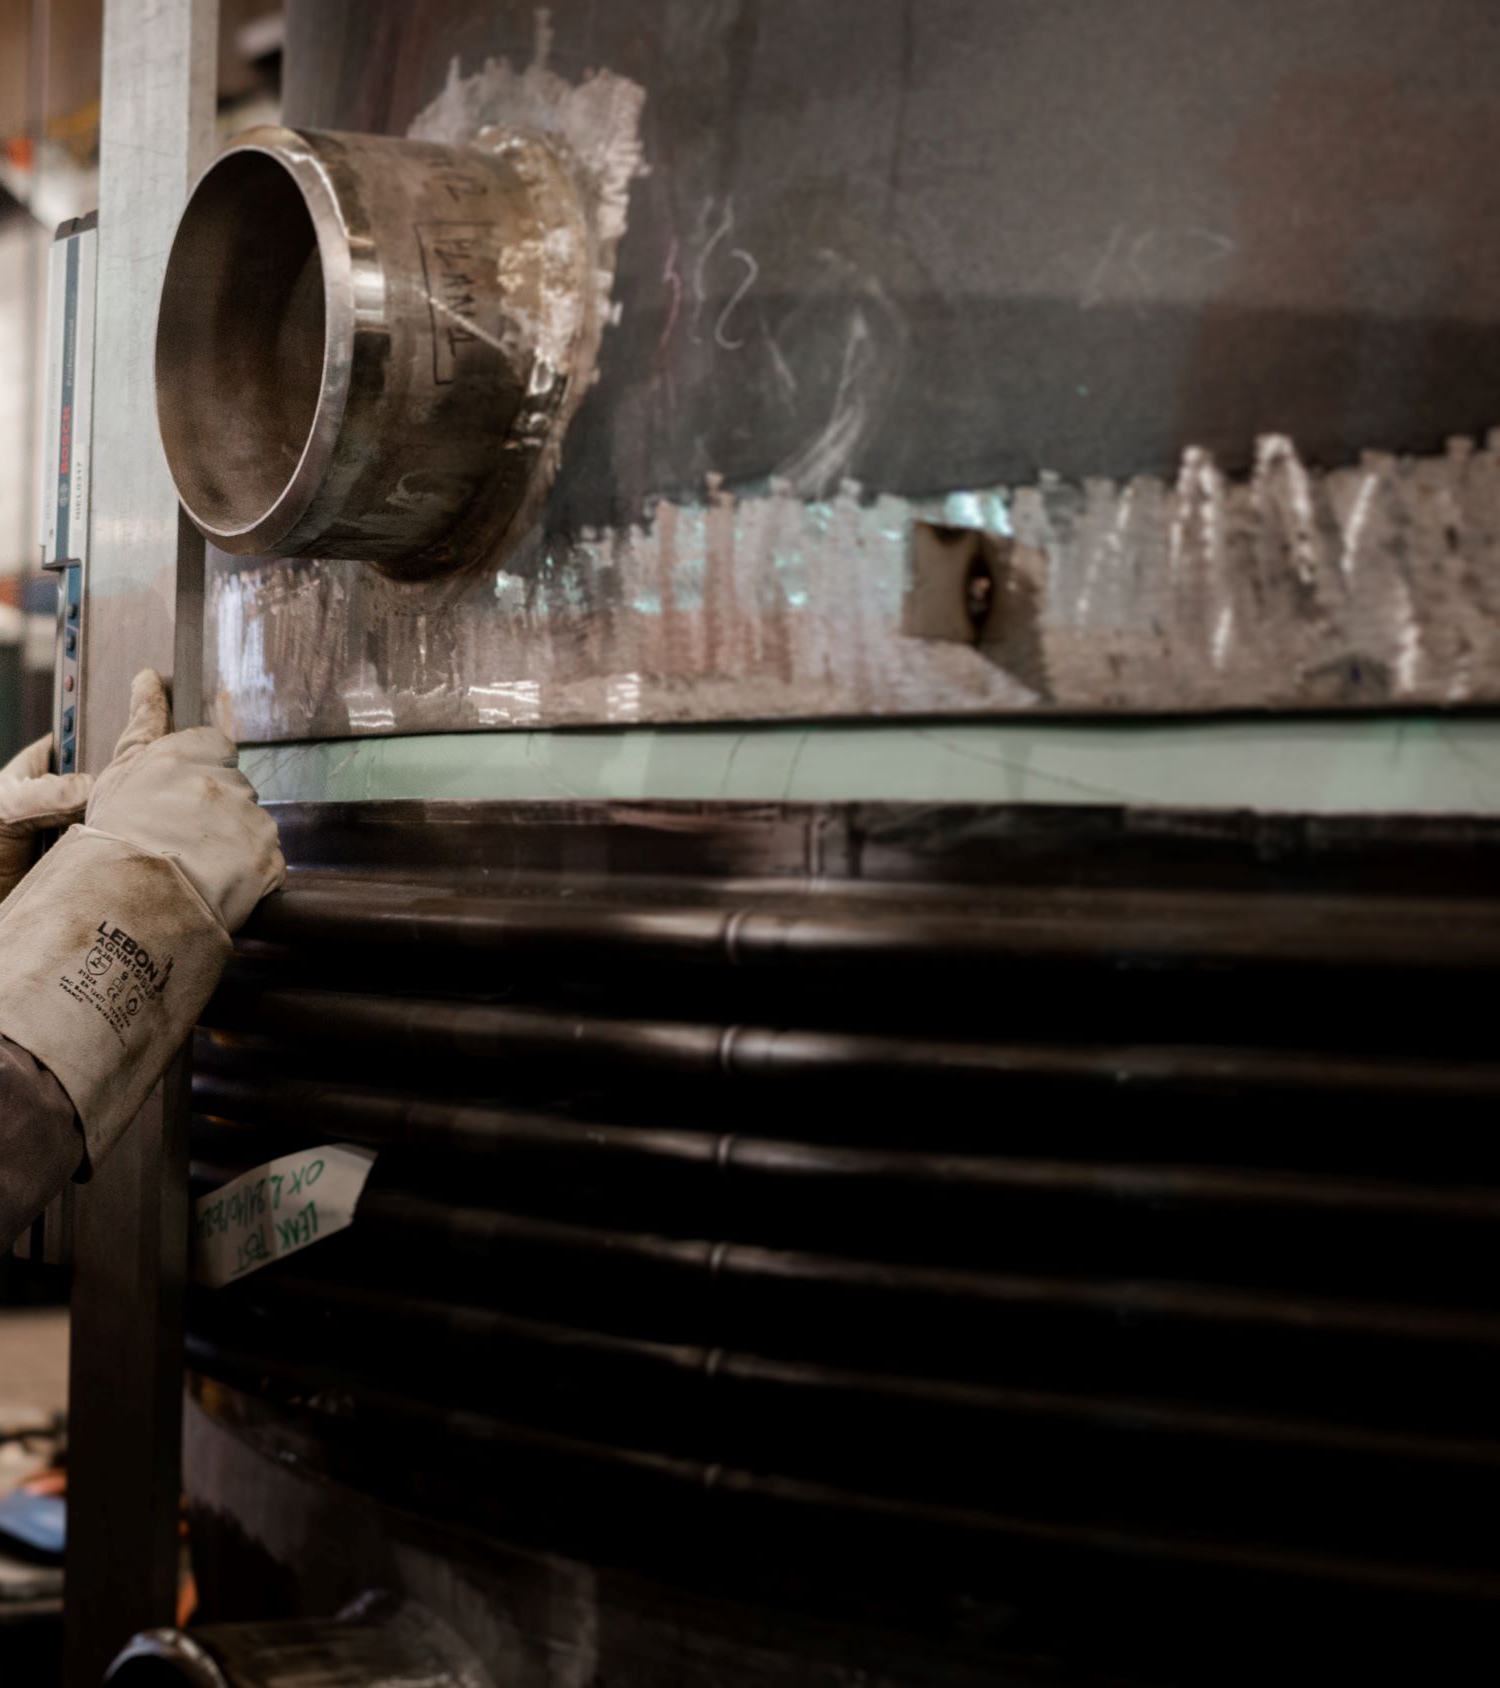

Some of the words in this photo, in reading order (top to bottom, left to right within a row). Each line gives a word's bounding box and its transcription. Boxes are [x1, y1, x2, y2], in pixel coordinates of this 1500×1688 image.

[59, 405, 72, 476] BOSCH
[67, 319, 75, 387] Professional
[97, 920, 160, 983] LEBON
[287, 1158, 325, 1196] OK
[276, 1200, 319, 1250] LEAK
